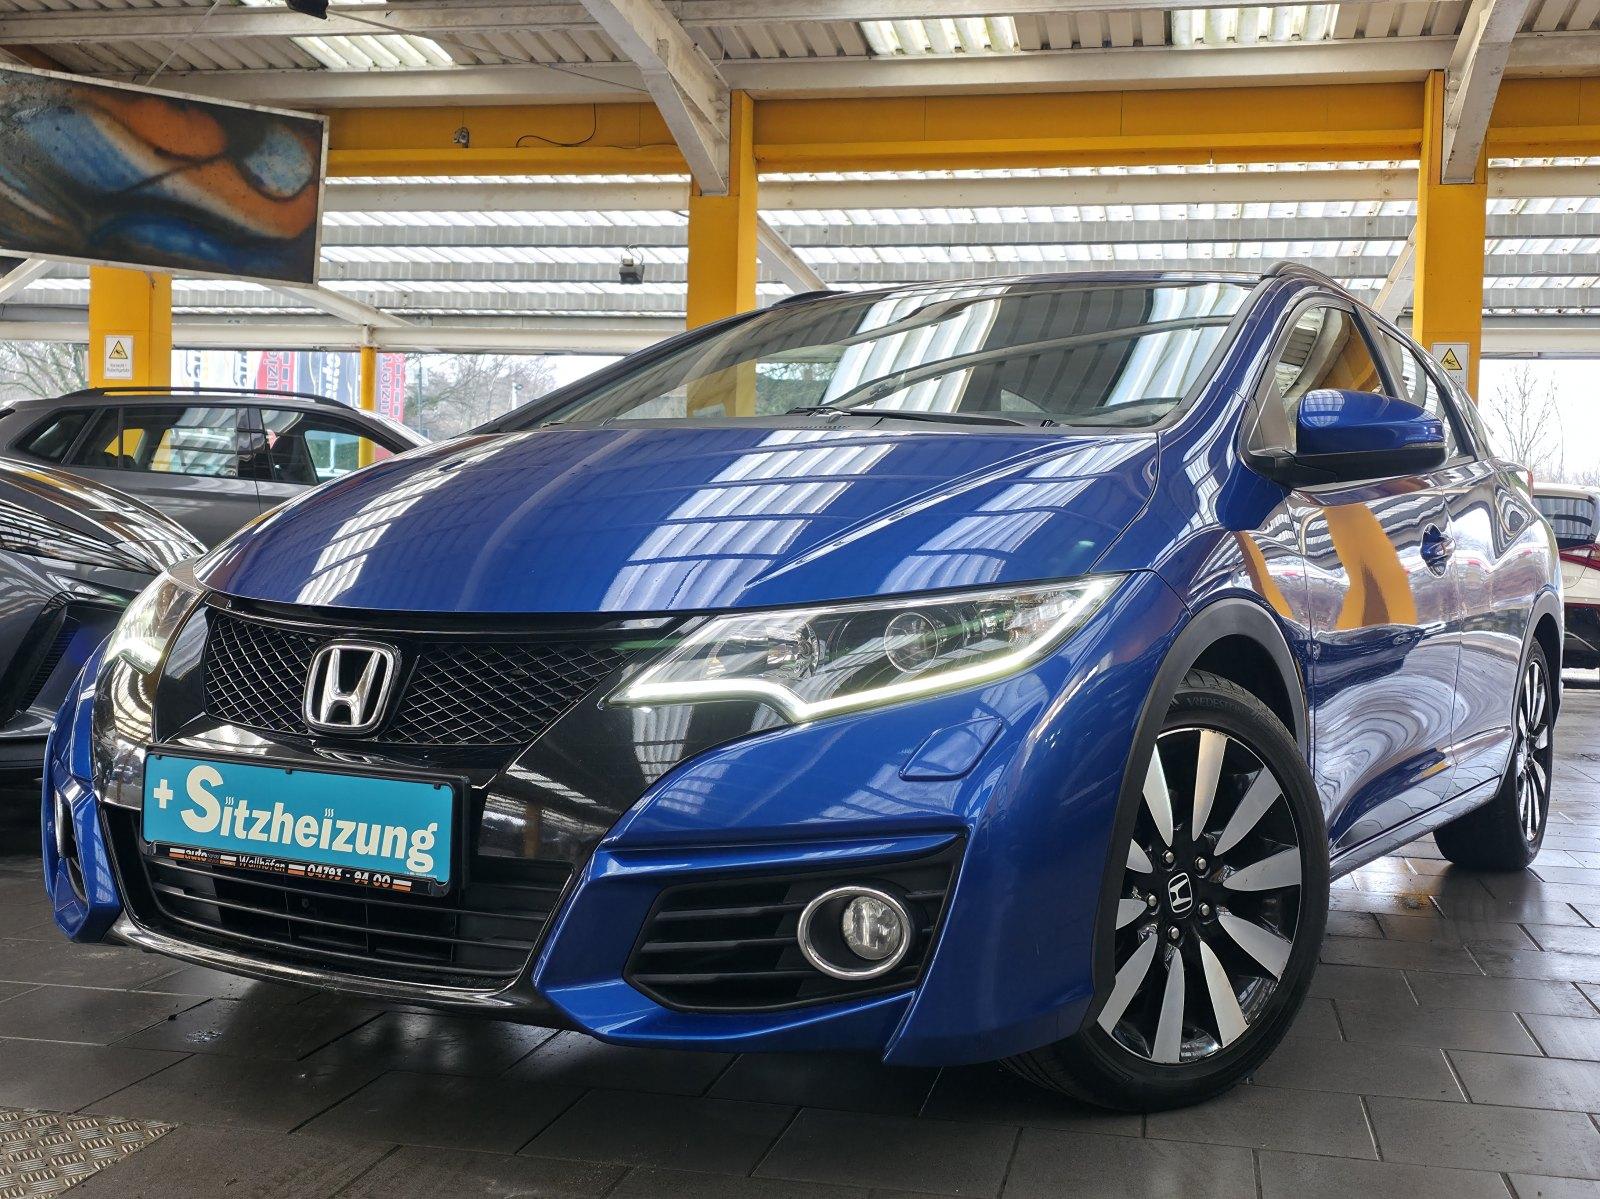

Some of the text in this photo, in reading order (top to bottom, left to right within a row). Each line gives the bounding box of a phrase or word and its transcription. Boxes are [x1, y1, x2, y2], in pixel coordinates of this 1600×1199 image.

[180, 764, 438, 873] Sitzheizung
[239, 855, 286, 872] Wallhöfen
[307, 863, 343, 881] 04793
[372, 873, 392, 888] 00
